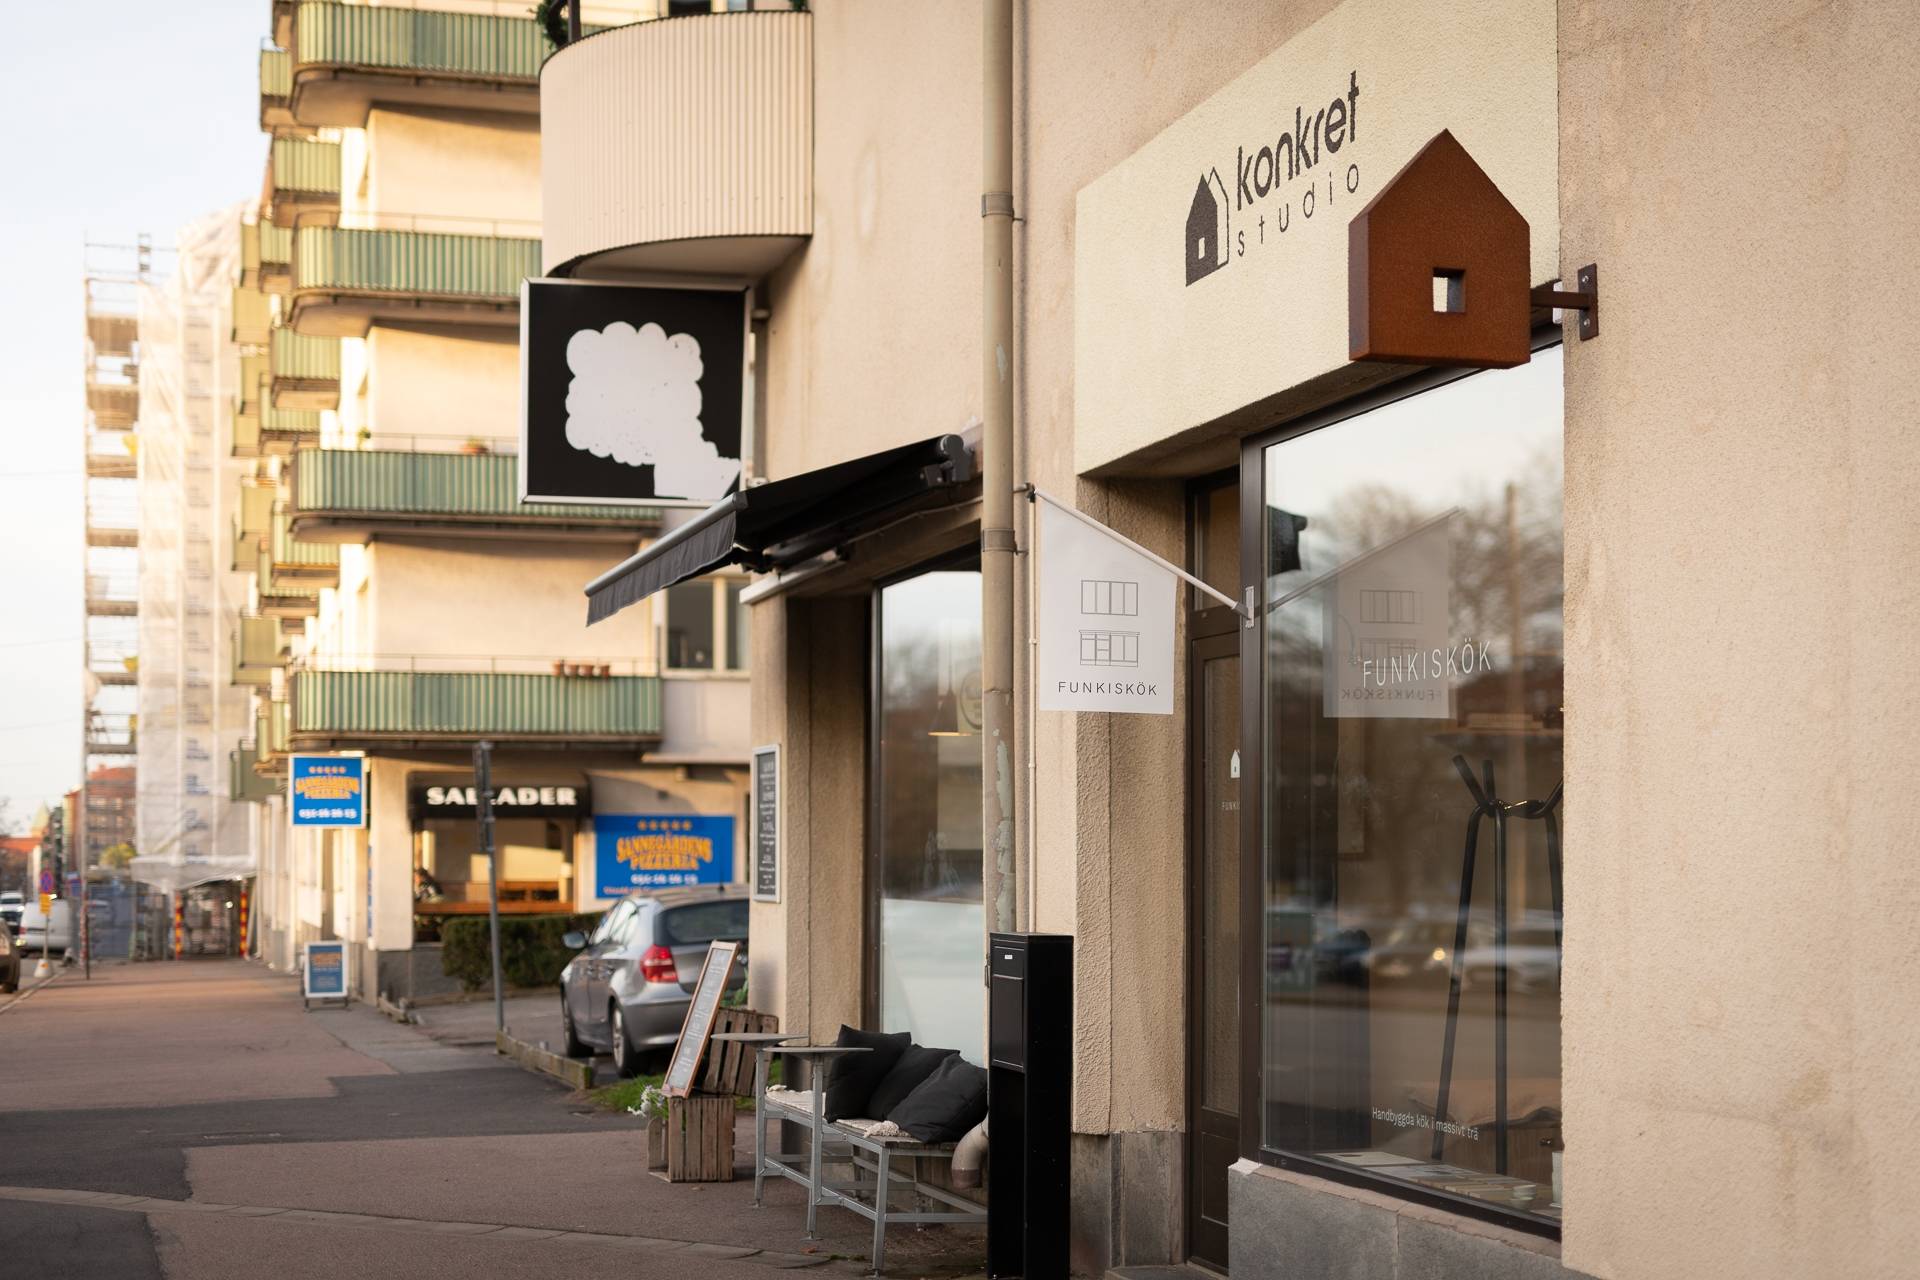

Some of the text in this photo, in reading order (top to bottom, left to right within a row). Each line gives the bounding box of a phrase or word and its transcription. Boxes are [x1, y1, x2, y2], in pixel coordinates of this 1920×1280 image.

[1237, 70, 1359, 211] konkret
[1237, 163, 1359, 257] studio
[1363, 637, 1491, 688] FUNKISKÖK
[1058, 681, 1157, 696] FUNKISKÖK
[426, 786, 577, 806] SALADER
[1372, 1107, 1414, 1128] Handbyggda
[1416, 1114, 1430, 1129] kök
[1436, 1120, 1466, 1136] massivt
[1467, 1127, 1479, 1141] trä
